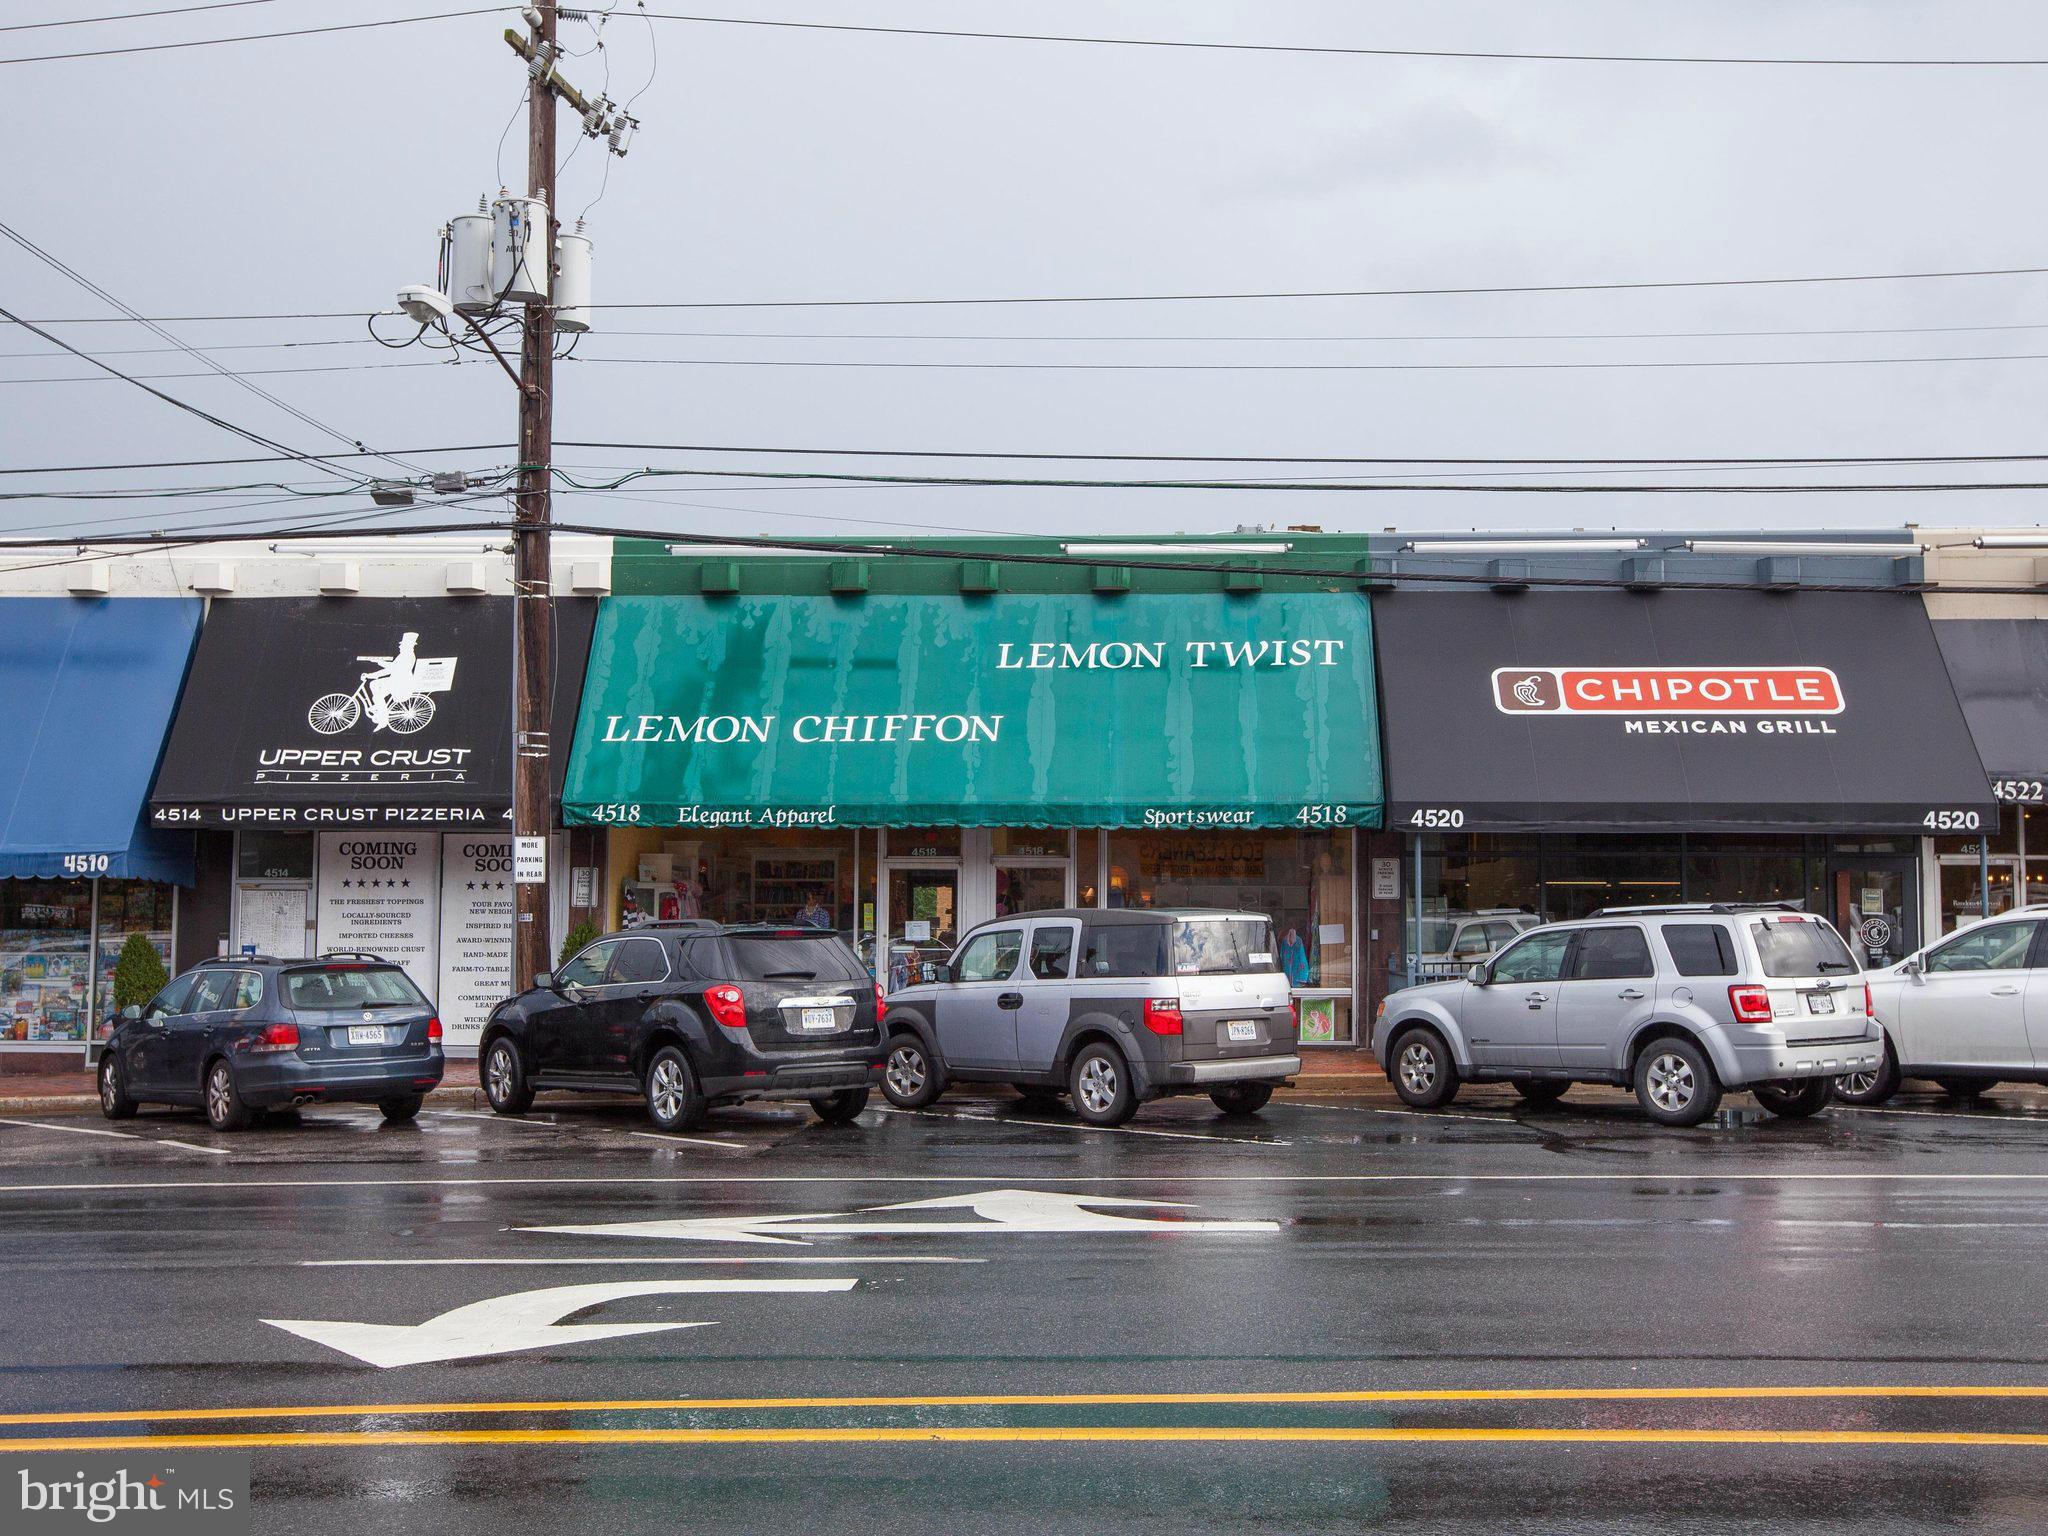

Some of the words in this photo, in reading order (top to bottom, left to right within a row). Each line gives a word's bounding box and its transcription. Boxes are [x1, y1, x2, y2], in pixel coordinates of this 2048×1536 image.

[995, 642, 1167, 669] LEMON
[1185, 639, 1344, 668] TWIST
[1575, 678, 1825, 701] CHIPOTLE
[601, 715, 775, 743] LEMON
[792, 714, 1004, 743] CHIFFON
[1624, 720, 1747, 734] MEXICAN
[1756, 720, 1837, 734] GRILL
[259, 749, 363, 766] UPPER
[370, 748, 471, 765] CRUST
[256, 773, 465, 781] PIZZERIA
[1993, 781, 2044, 800] 4522
[154, 808, 202, 821] 4514
[222, 808, 297, 821] UPPER
[304, 808, 378, 821] CRUST
[385, 808, 486, 821] PIZZERIA
[591, 804, 641, 823] 4518
[678, 806, 752, 829] Elegant
[758, 805, 836, 828] Apparel
[1144, 808, 1255, 828] Sportswear
[1296, 804, 1347, 824] 4518
[1410, 809, 1464, 828] 4520
[1923, 811, 1980, 830] 4520
[339, 842, 417, 855] COMING
[463, 844, 512, 858] COMI
[911, 847, 937, 856] 4518
[1018, 846, 1044, 856] 4518
[64, 854, 109, 872] 4510
[351, 857, 405, 870] SOON
[475, 859, 512, 872] SOO
[264, 869, 289, 877] 4514
